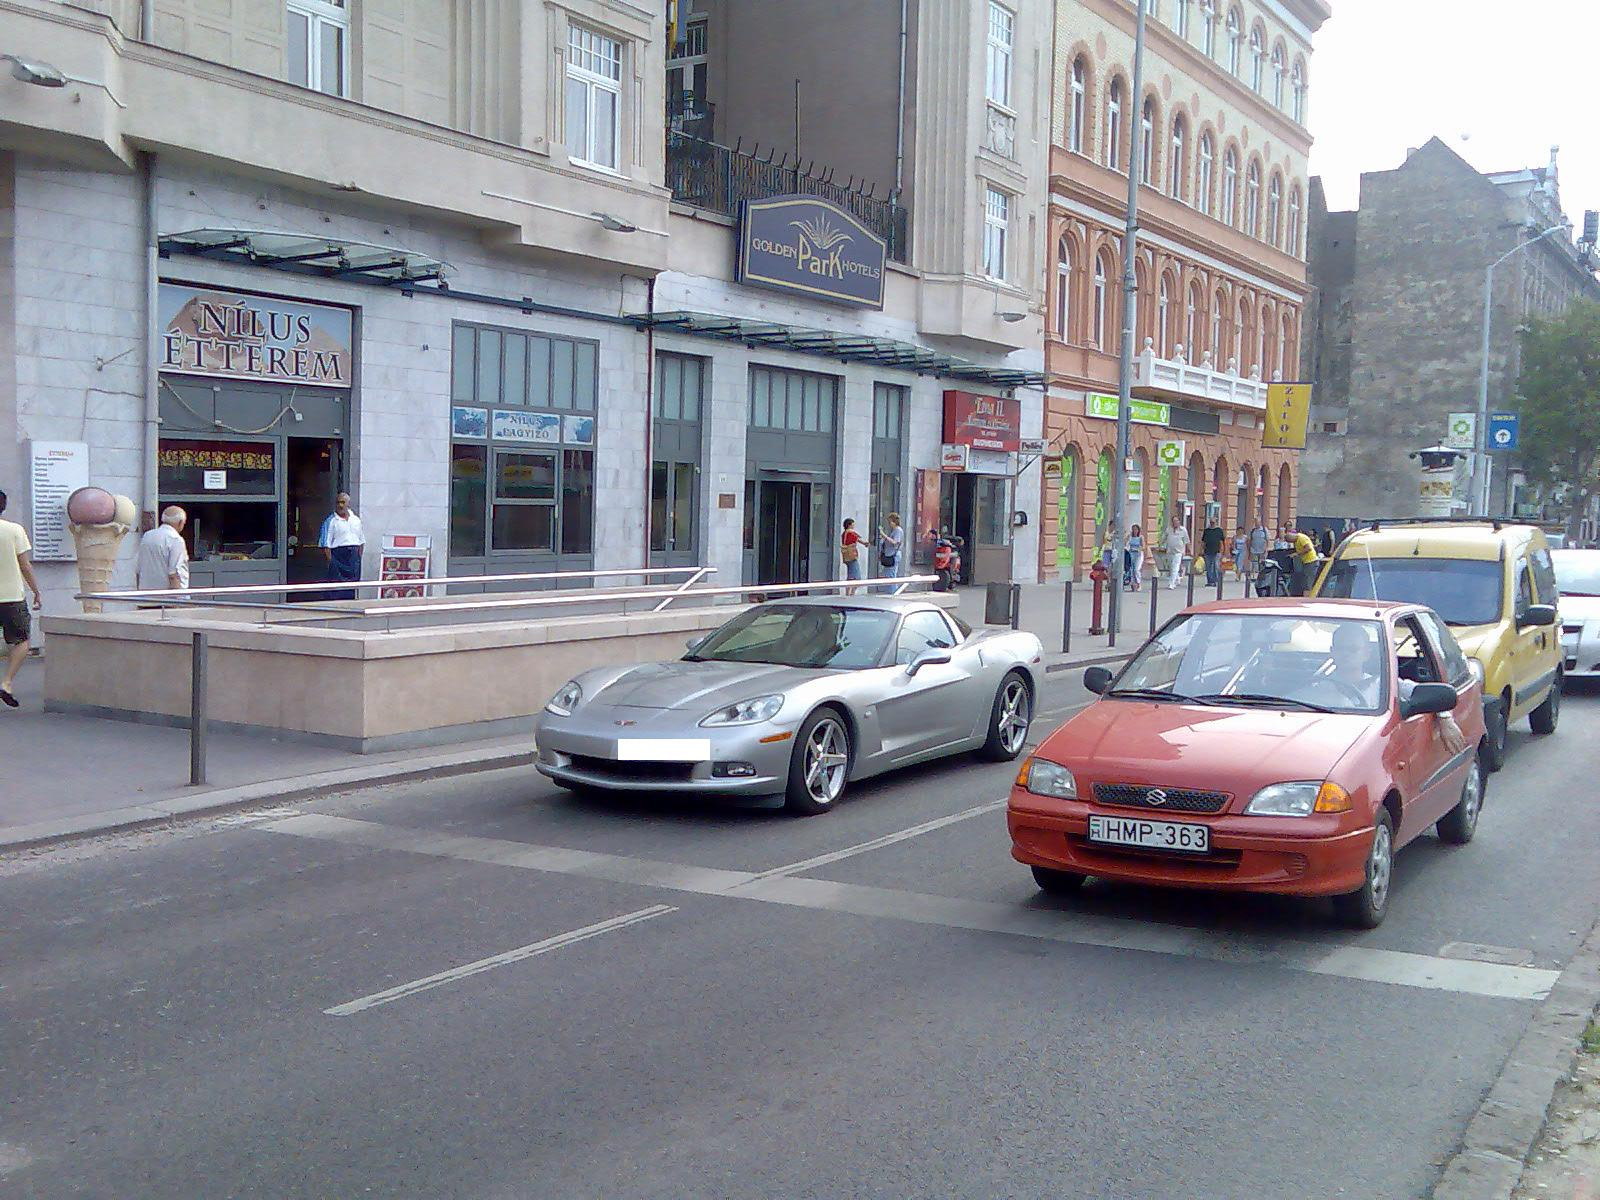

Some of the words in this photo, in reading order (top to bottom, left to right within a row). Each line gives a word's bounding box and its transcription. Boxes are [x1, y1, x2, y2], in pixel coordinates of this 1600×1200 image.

[752, 238, 797, 259] GOLDEN
[842, 260, 881, 280] HOTELS
[199, 299, 312, 345] NÍLUS
[162, 327, 344, 382] ÉTTEREM
[1106, 820, 1206, 849] HMP-363
